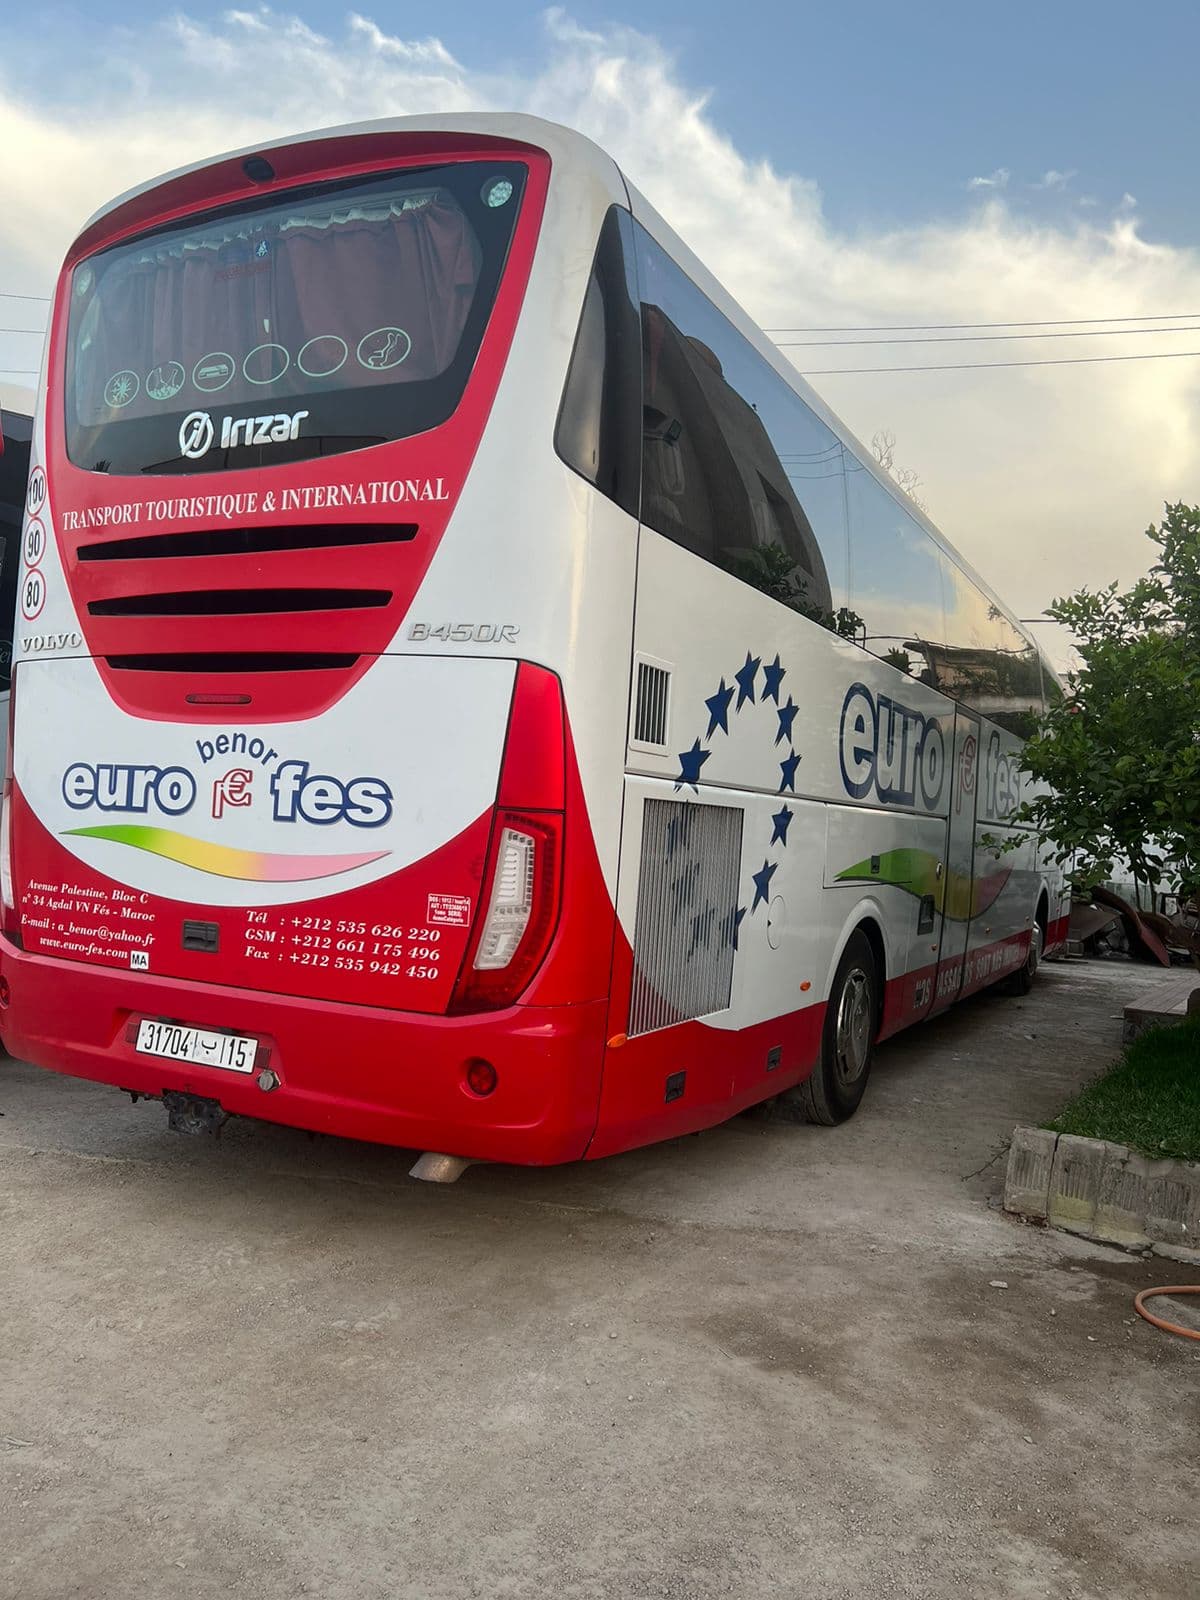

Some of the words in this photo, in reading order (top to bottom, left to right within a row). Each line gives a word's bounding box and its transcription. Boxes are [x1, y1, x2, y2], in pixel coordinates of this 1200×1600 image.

[220, 410, 309, 449] Irizar
[28, 474, 44, 507] 100
[62, 502, 142, 531] TRANSPORT
[145, 492, 258, 521] TOURISTIQUE
[262, 490, 276, 513] &
[281, 477, 450, 510] INTERNATIONAL
[27, 529, 40, 558] 90
[26, 580, 40, 609] 80
[20, 632, 82, 653] VOLVO
[407, 622, 521, 643] B450R
[195, 732, 278, 766] benor
[839, 682, 945, 811] euro
[62, 762, 197, 817] euro
[270, 760, 394, 829] fes
[27, 879, 58, 893] Avenue
[61, 883, 108, 900] Palestine,
[111, 889, 136, 903] Bloc
[140, 893, 149, 905] C
[32, 894, 45, 905] 34
[46, 896, 73, 911] Agdal
[75, 901, 91, 913] VN
[92, 903, 110, 916] Fés
[120, 907, 156, 922] Maroc
[21, 913, 50, 929] E-mail
[57, 921, 156, 947] a_benor@yahoo.fr
[246, 910, 268, 924] Tél
[291, 916, 332, 931] +212
[336, 920, 367, 935] 535
[371, 924, 402, 939] 626
[407, 927, 441, 942] 220
[39, 936, 128, 959] www.euro-fes.com
[131, 953, 147, 967] MA
[245, 928, 276, 943] GSM
[291, 934, 332, 949] +212
[336, 938, 365, 953] 661
[371, 942, 402, 958] 175
[407, 946, 441, 962] 496
[244, 945, 270, 960] Fax
[289, 952, 330, 968] +212
[334, 956, 365, 972] 535
[369, 960, 401, 976] 942
[405, 964, 439, 980] 450
[144, 1024, 192, 1057] 31704
[229, 1038, 248, 1068] 15
